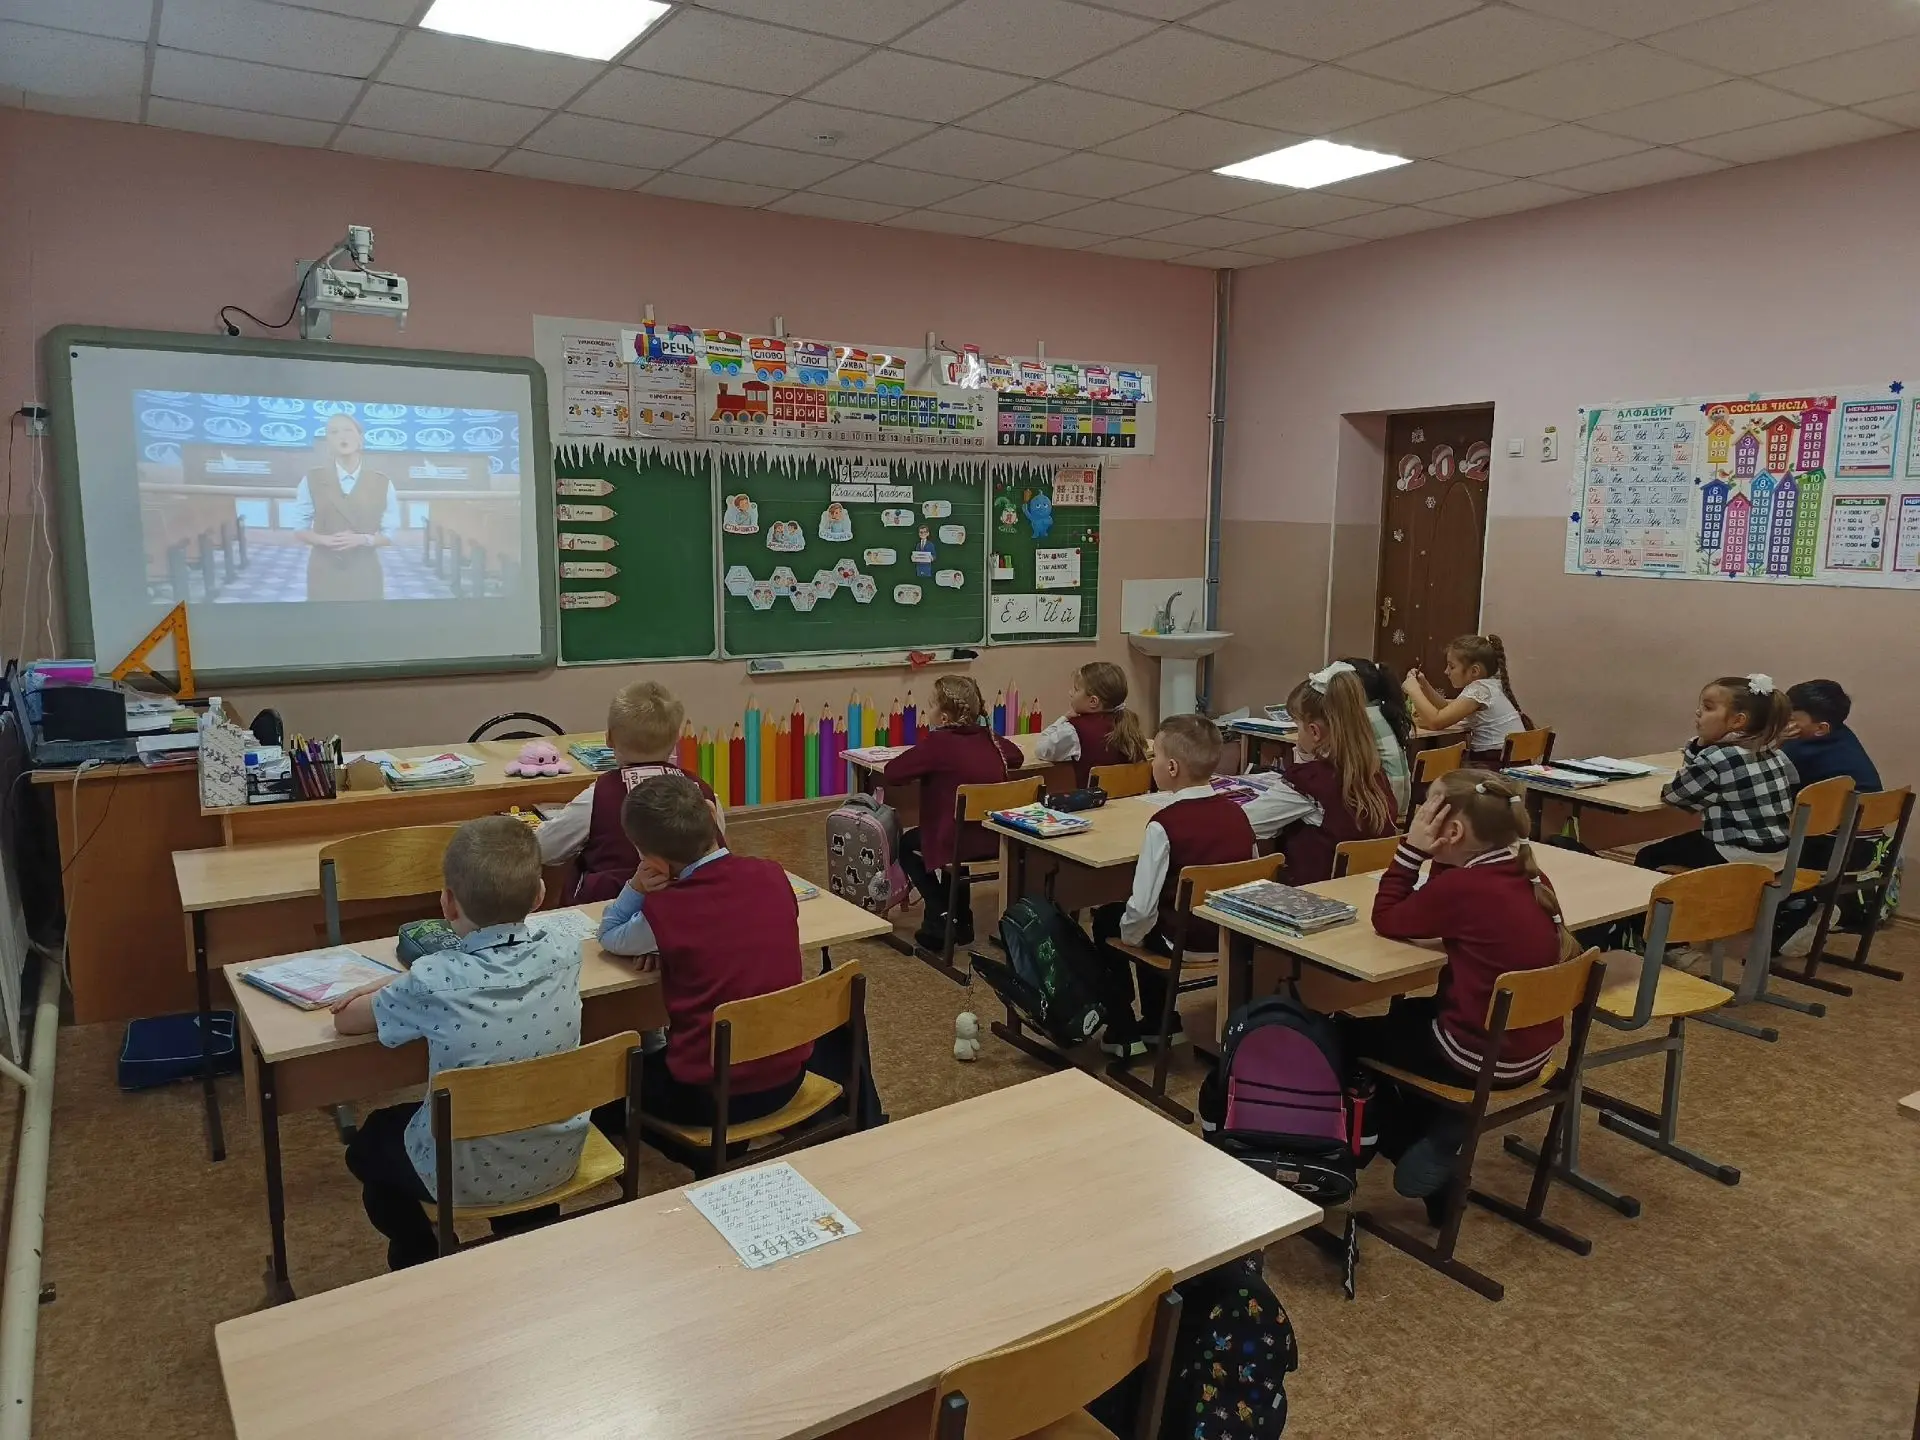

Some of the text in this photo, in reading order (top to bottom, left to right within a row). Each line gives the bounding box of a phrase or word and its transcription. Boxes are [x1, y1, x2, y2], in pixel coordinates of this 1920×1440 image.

[662, 342, 694, 354] РЕЧЬ
[754, 351, 783, 360] СЛОВО
[801, 356, 820, 364] СЛОГ
[880, 368, 898, 378] ЗВУК
[1730, 401, 1808, 412] СОСТАВ ЧИСЛА
[1617, 408, 1674, 418] АЛФАВИТ
[1812, 414, 1818, 422] 5
[1004, 434, 1130, 446] 9 8 7 6 5 4 3 2 1
[1810, 474, 1820, 482] 10
[1784, 481, 1790, 490] 9
[1734, 500, 1742, 508] 7
